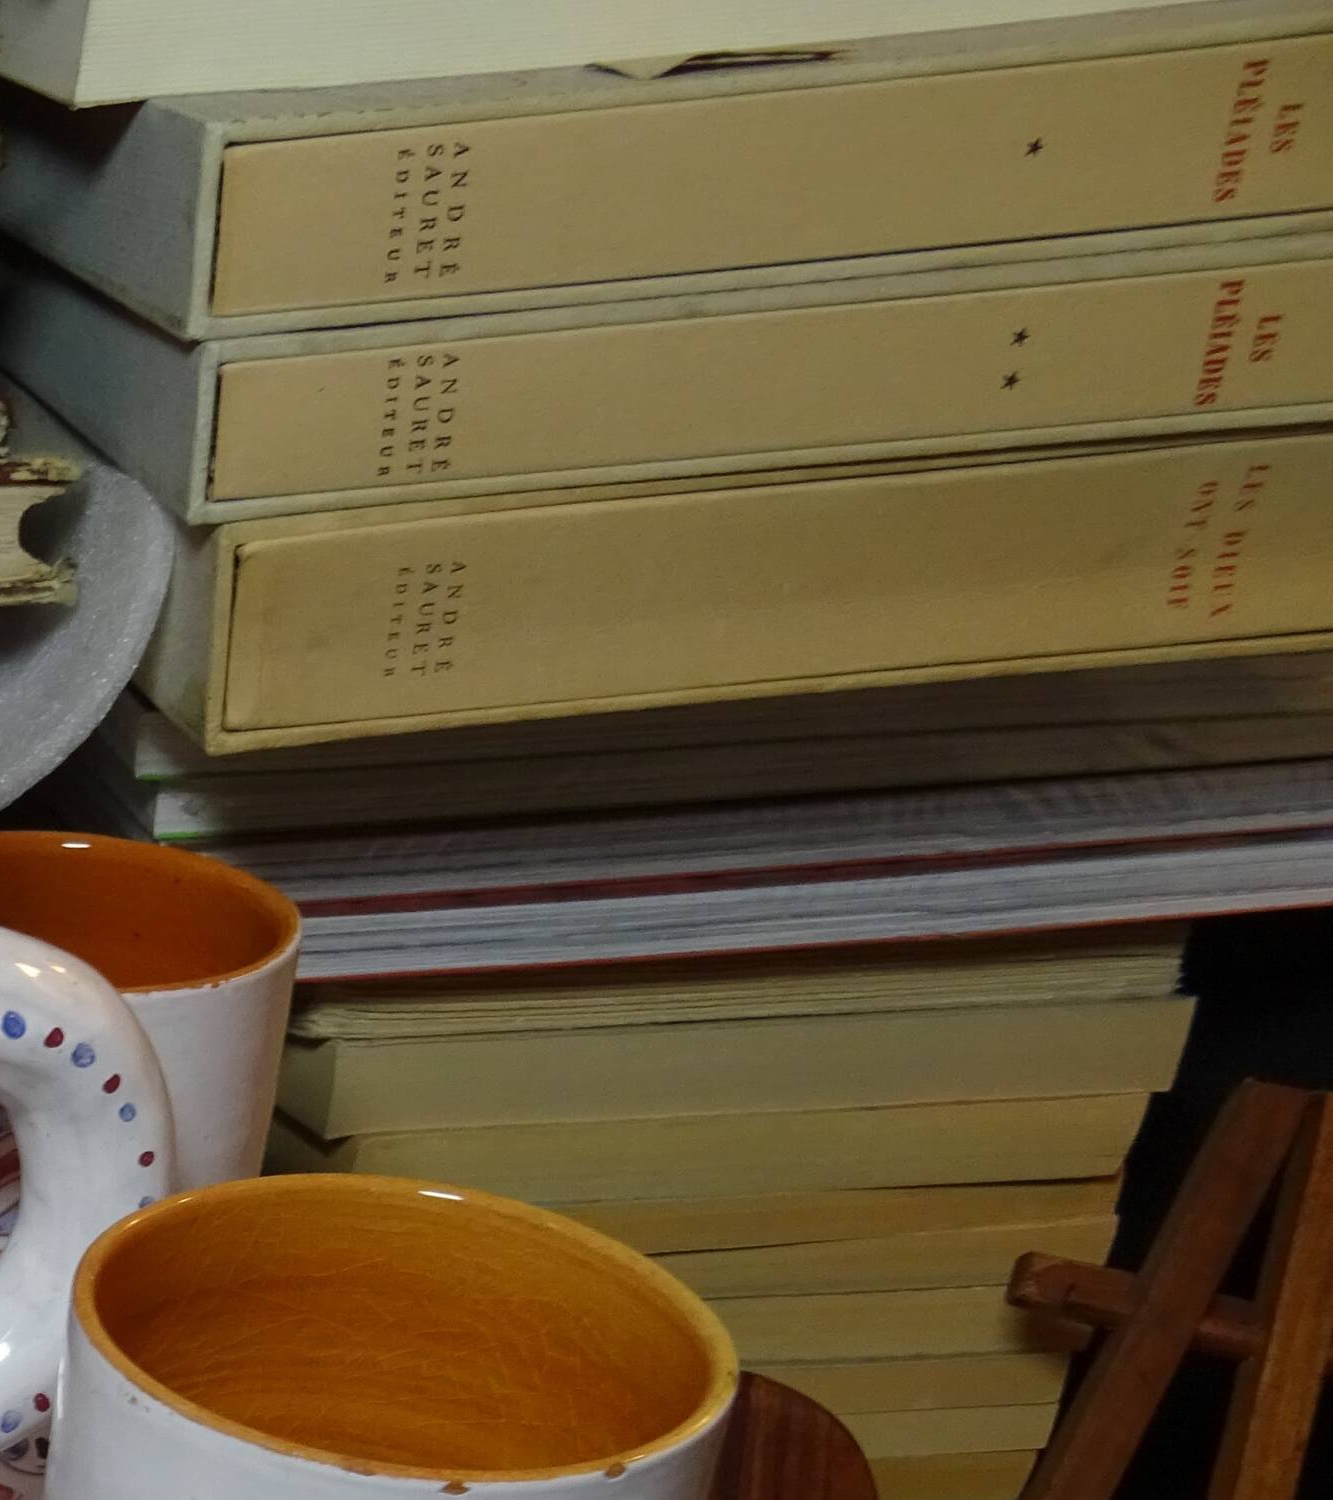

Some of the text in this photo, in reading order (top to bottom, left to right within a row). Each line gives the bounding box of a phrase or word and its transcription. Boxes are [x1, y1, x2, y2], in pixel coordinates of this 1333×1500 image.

[1269, 102, 1304, 155] LES
[384, 147, 414, 286] ÉDITEUR
[412, 142, 446, 282] SAURET
[438, 141, 472, 280] ANDRÉ
[1248, 312, 1284, 364] LES
[377, 357, 405, 480] ÉDITEUR
[405, 354, 435, 475] SAURET
[431, 352, 462, 474] ANDRÉ
[383, 566, 413, 679] ÉDITEUR
[409, 562, 444, 678] SAURET
[433, 560, 467, 675] ANDRÉ
